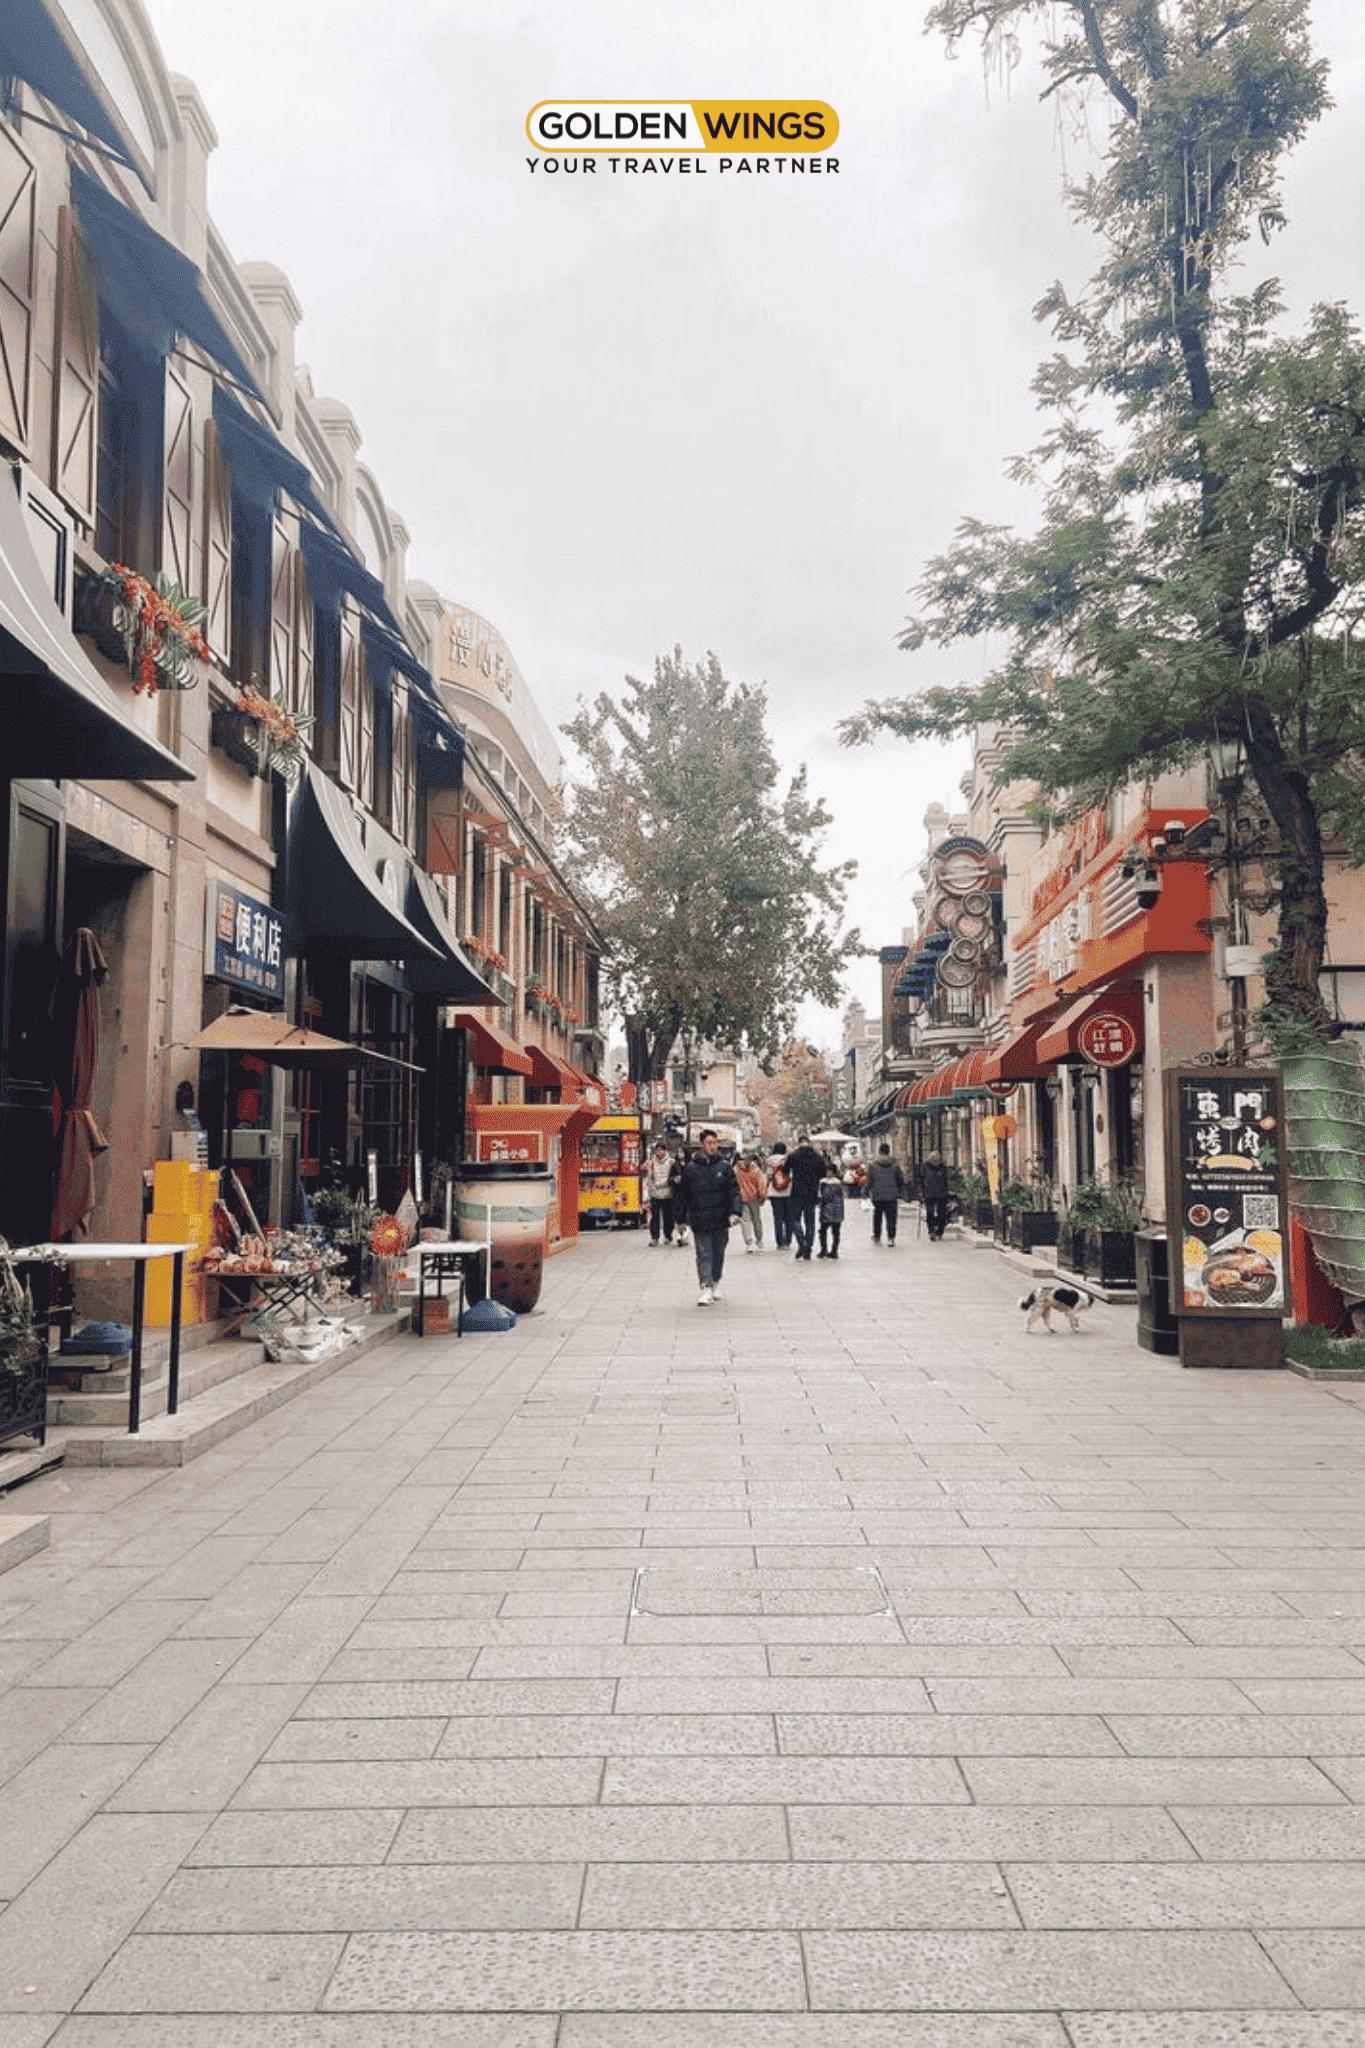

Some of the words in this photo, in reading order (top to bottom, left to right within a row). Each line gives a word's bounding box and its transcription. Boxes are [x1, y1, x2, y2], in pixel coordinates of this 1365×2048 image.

[236, 902, 282, 968] 便利店
[1196, 1124, 1261, 1156] 烤肉
